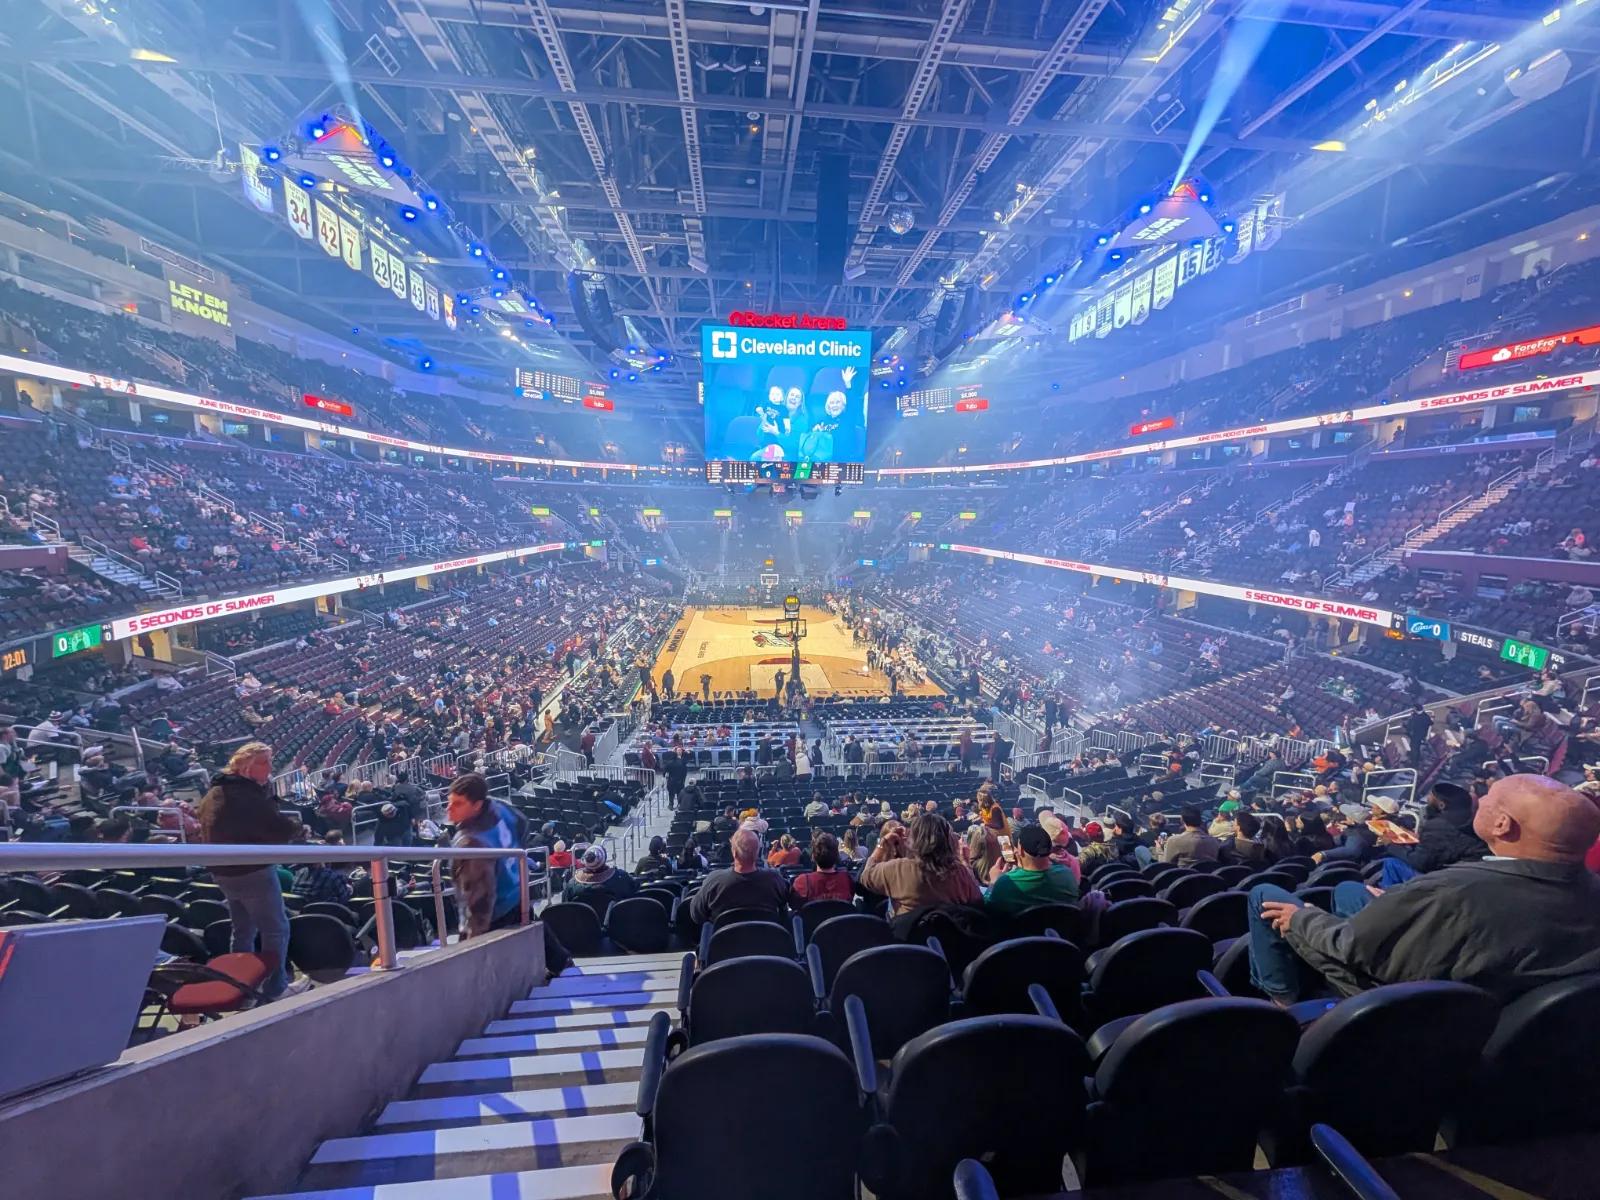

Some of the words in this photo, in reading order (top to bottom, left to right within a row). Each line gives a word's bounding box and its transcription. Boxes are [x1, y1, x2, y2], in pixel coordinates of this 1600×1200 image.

[290, 199, 310, 231] 34
[321, 221, 337, 249] 42
[347, 238, 354, 259] 7
[374, 258, 388, 281] 22
[1182, 254, 1198, 281] 15
[392, 270, 404, 292] 25
[169, 279, 202, 302] LET
[204, 293, 228, 312] EM
[412, 284, 423, 305] 43
[171, 294, 232, 327] KNOW.
[745, 312, 798, 328] Rocket
[801, 315, 846, 330] Arena
[740, 338, 816, 356] Cleveland
[819, 340, 862, 357] Clinic
[1430, 393, 1489, 407] SECONDS
[1491, 388, 1510, 397] OF
[1512, 375, 1584, 395] SUMMER
[128, 620, 138, 632] 5
[140, 607, 204, 629] SECONDS
[206, 603, 223, 616] OF
[225, 594, 275, 612] SUMMER
[1245, 591, 1252, 599] 5
[1253, 593, 1303, 608] SECONDS
[1304, 600, 1321, 610] OF
[1322, 603, 1378, 622] SUMMER
[1396, 621, 1401, 629] 0
[1433, 624, 1441, 636] 0
[59, 637, 68, 652] 0
[104, 632, 112, 641] 0
[1461, 631, 1493, 649] STEALS
[3, 649, 27, 671] 22:01
[1508, 644, 1516, 658] 0
